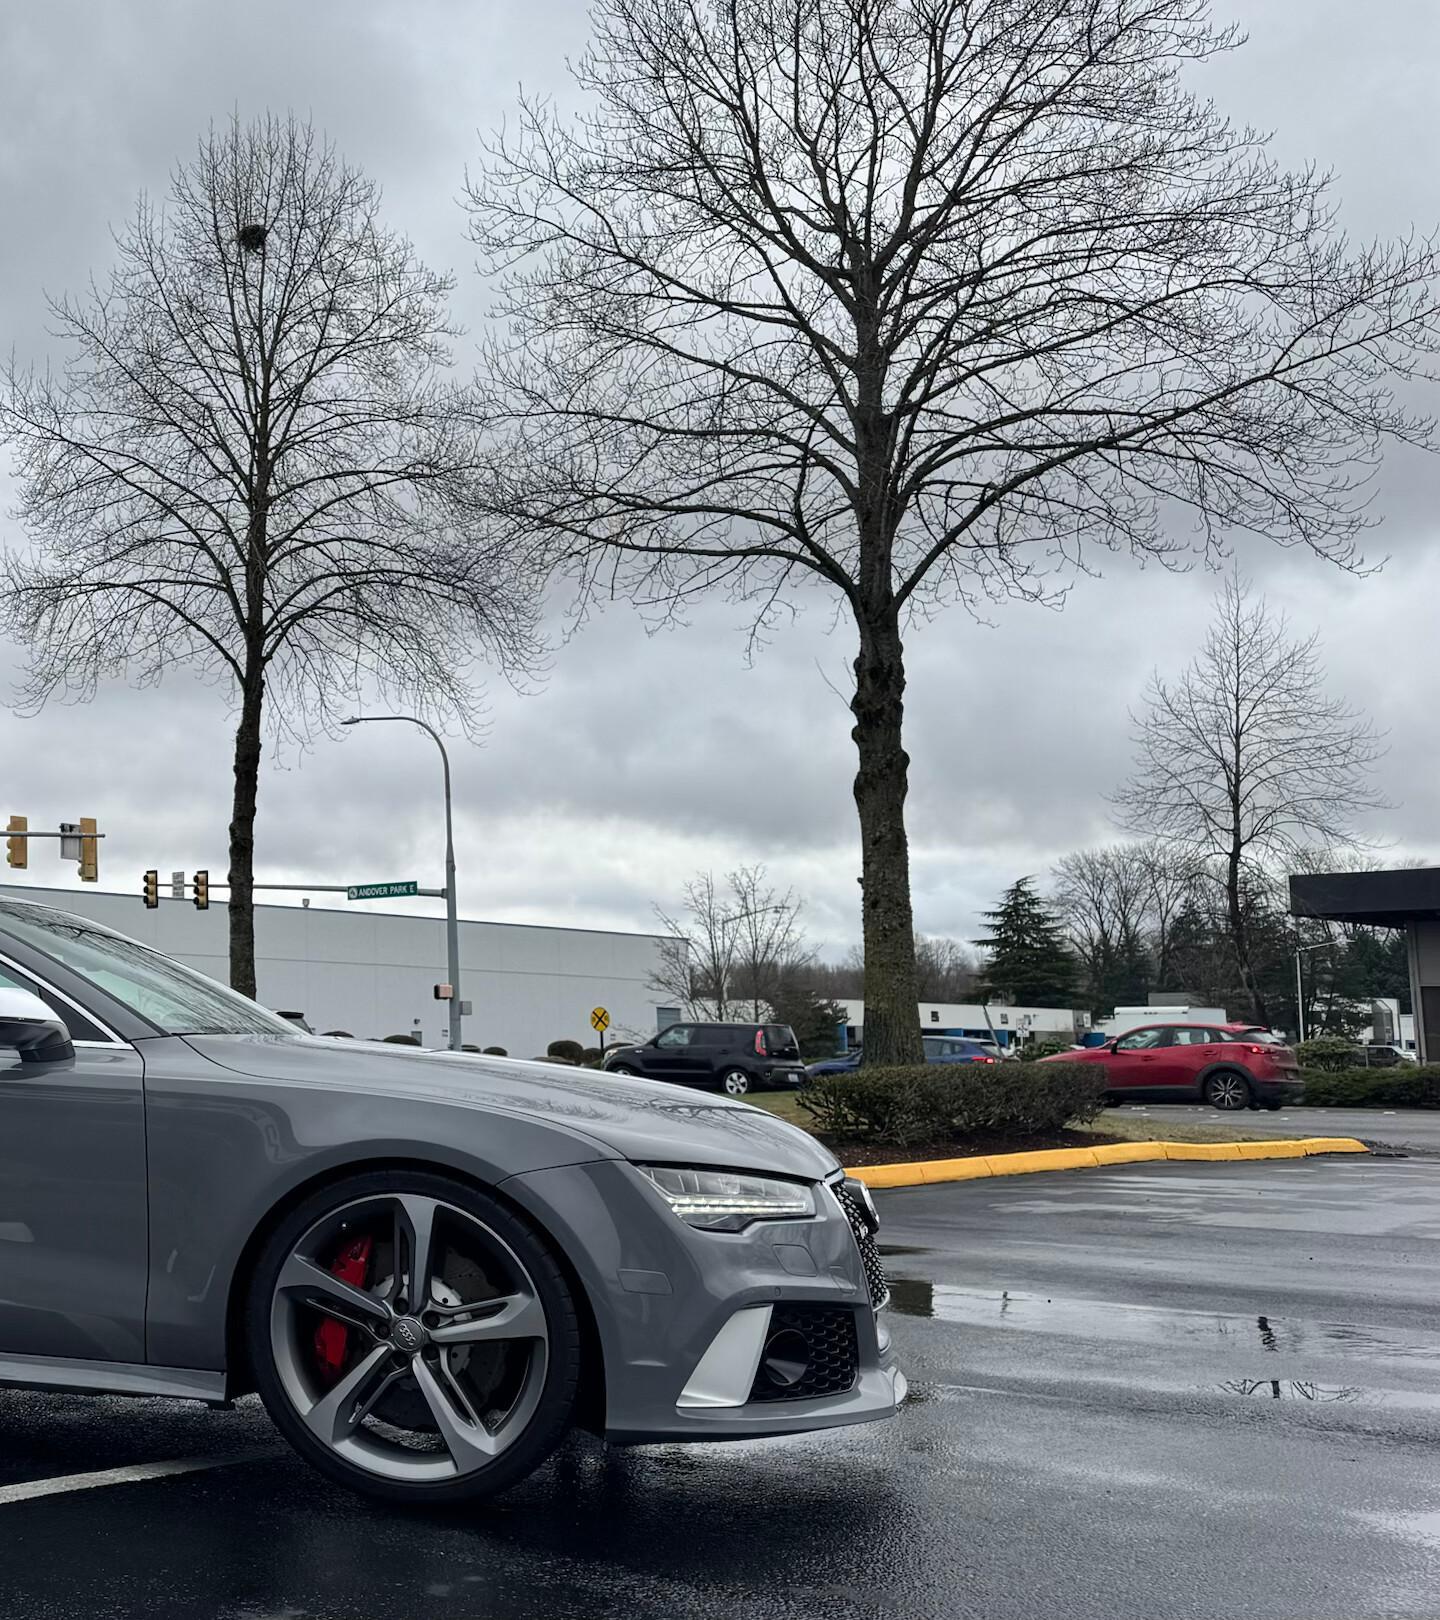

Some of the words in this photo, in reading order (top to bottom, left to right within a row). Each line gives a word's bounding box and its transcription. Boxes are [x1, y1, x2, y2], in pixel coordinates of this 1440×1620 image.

[358, 887, 388, 897] ANDOVER
[389, 885, 407, 895] PARK
[409, 884, 415, 893] E
